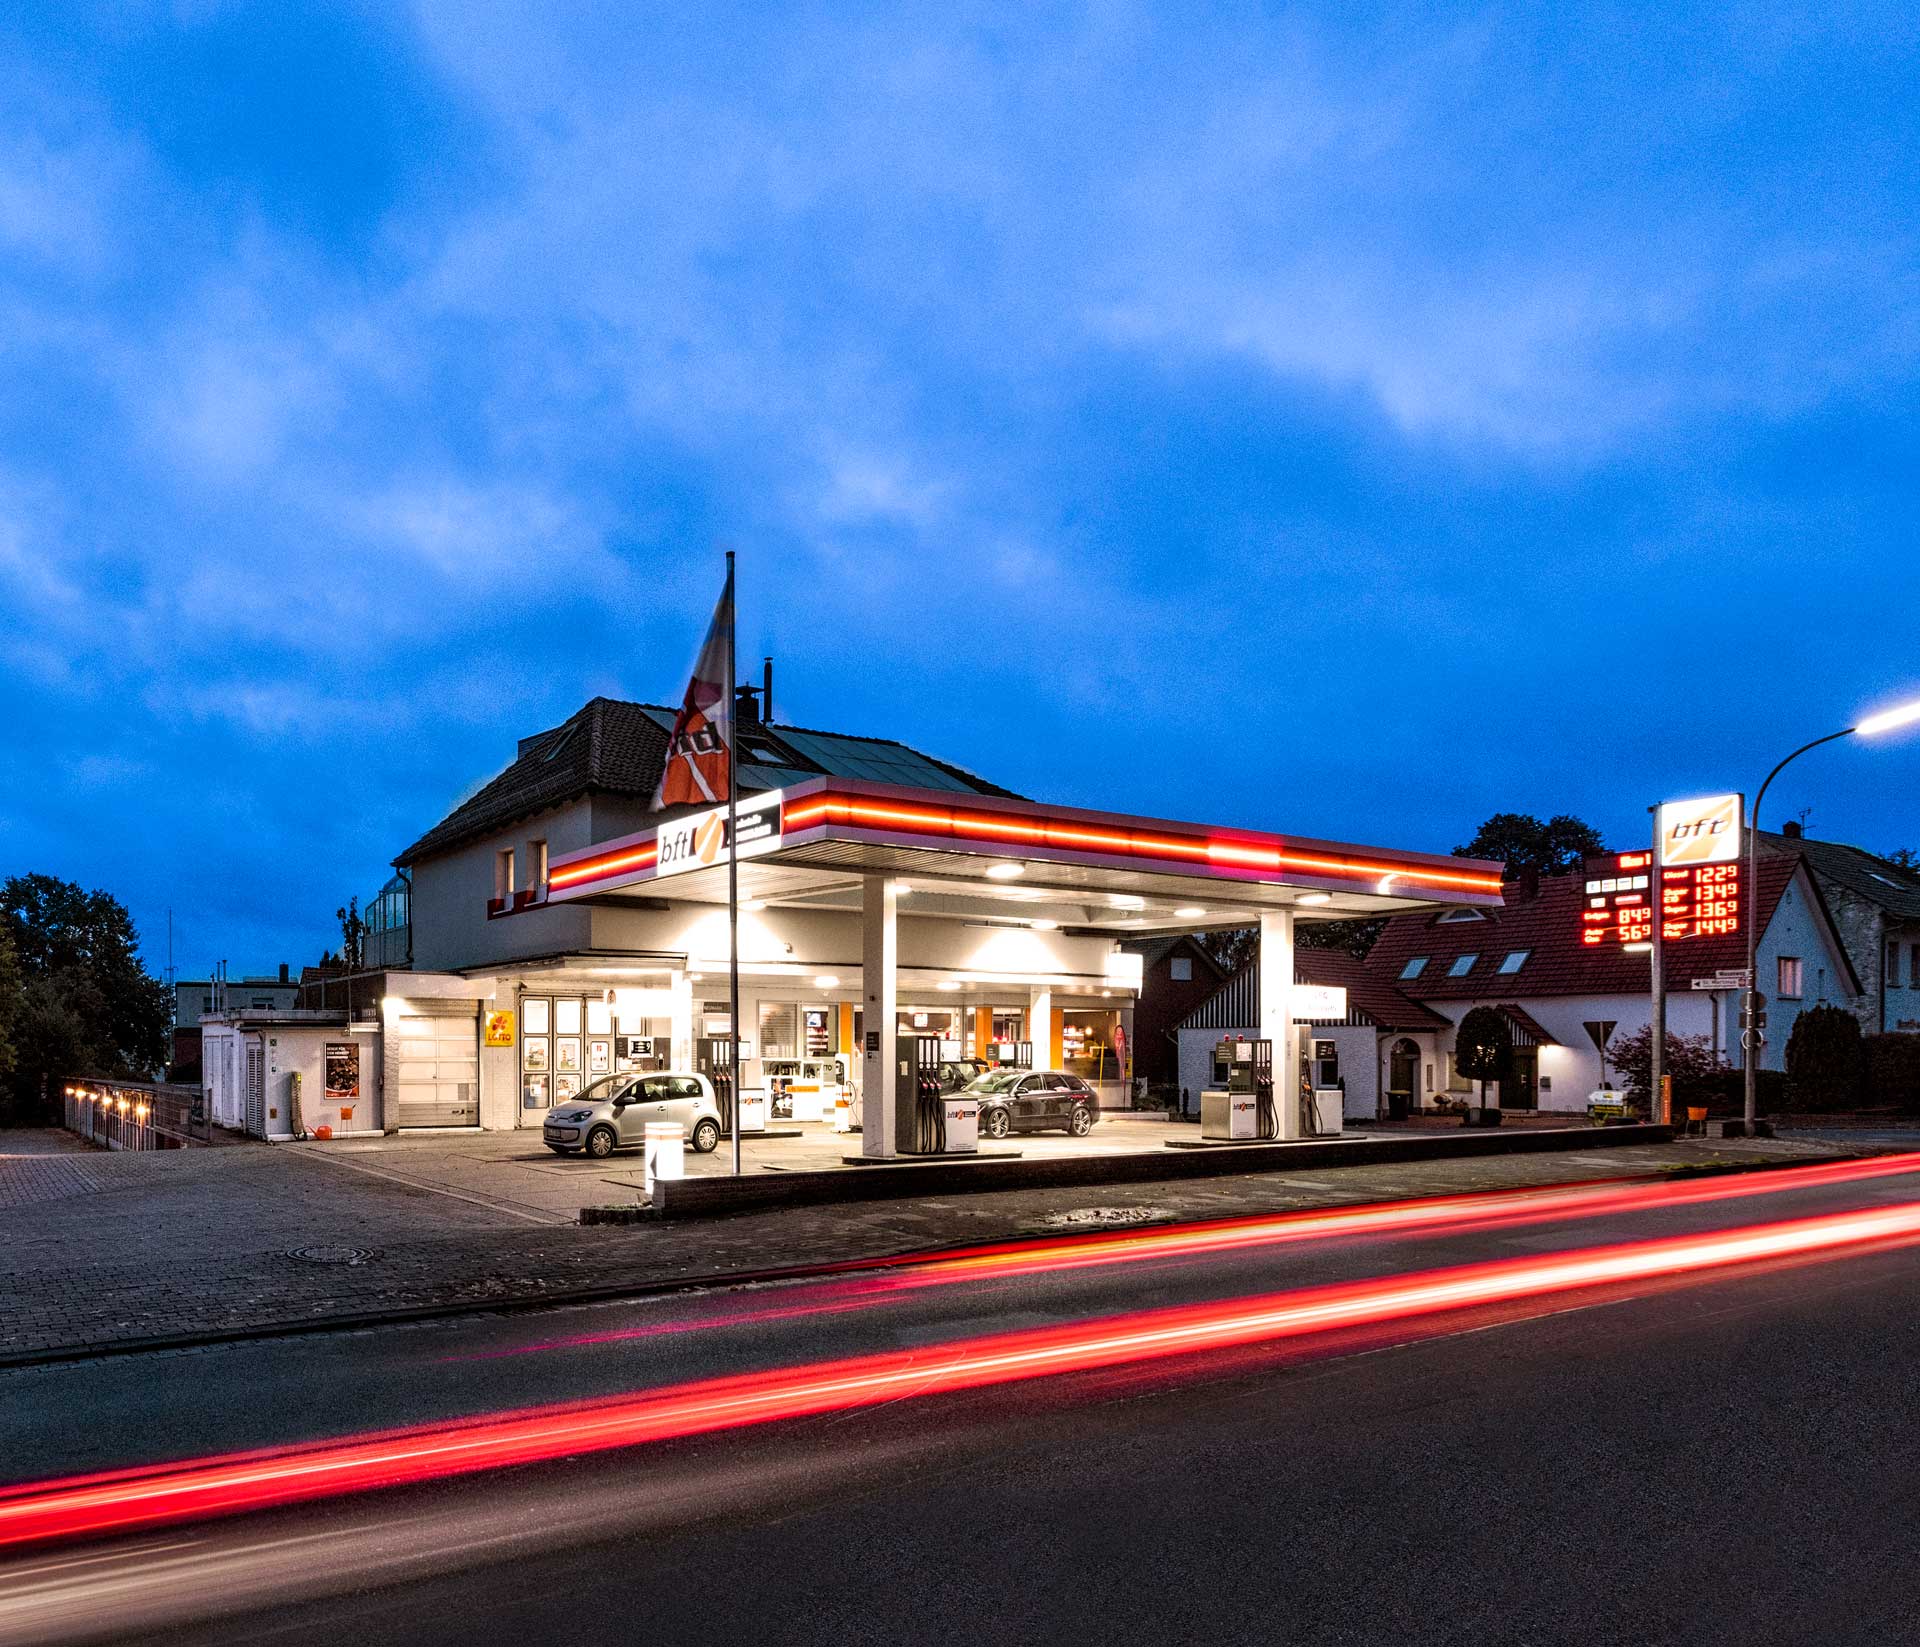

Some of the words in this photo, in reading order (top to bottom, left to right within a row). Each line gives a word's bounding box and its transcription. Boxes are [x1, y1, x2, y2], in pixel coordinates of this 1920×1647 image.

[1672, 818, 1726, 839] bft
[660, 831, 688, 864] bft
[1696, 865, 1737, 883] 1229
[1696, 883, 1737, 900] 1349
[1619, 908, 1651, 924] 849
[1663, 906, 1689, 914] Super
[1696, 900, 1737, 917] 1369
[1619, 924, 1651, 941] 569
[1696, 918, 1737, 935] 1449
[488, 1033, 512, 1041] LOTTO
